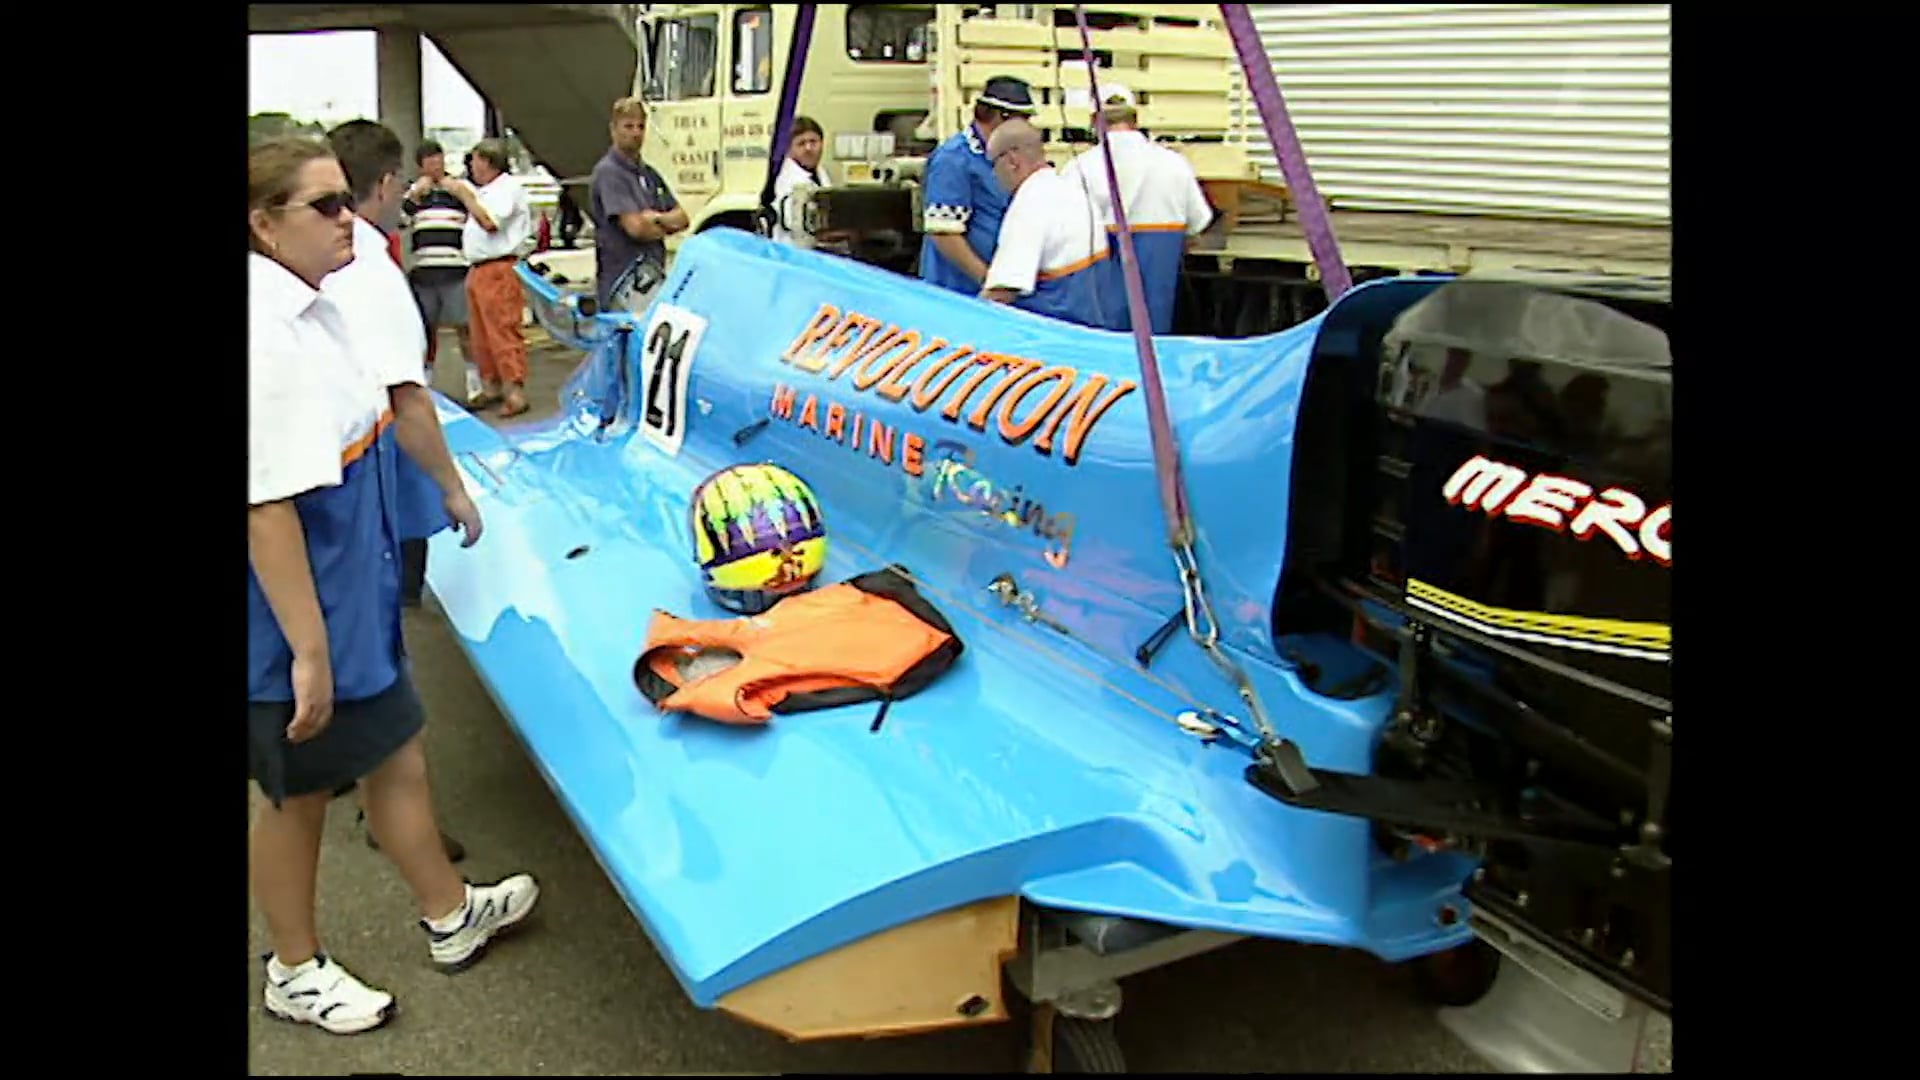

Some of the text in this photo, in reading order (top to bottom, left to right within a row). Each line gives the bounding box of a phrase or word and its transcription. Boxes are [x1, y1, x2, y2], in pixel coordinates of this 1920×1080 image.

[673, 116, 708, 128] TRUCK
[671, 151, 709, 165] CRANE
[678, 171, 705, 183] HIRE
[646, 320, 691, 437] 21
[779, 303, 1137, 466] REVOLUTION
[771, 384, 1076, 569] MARINE Racing
